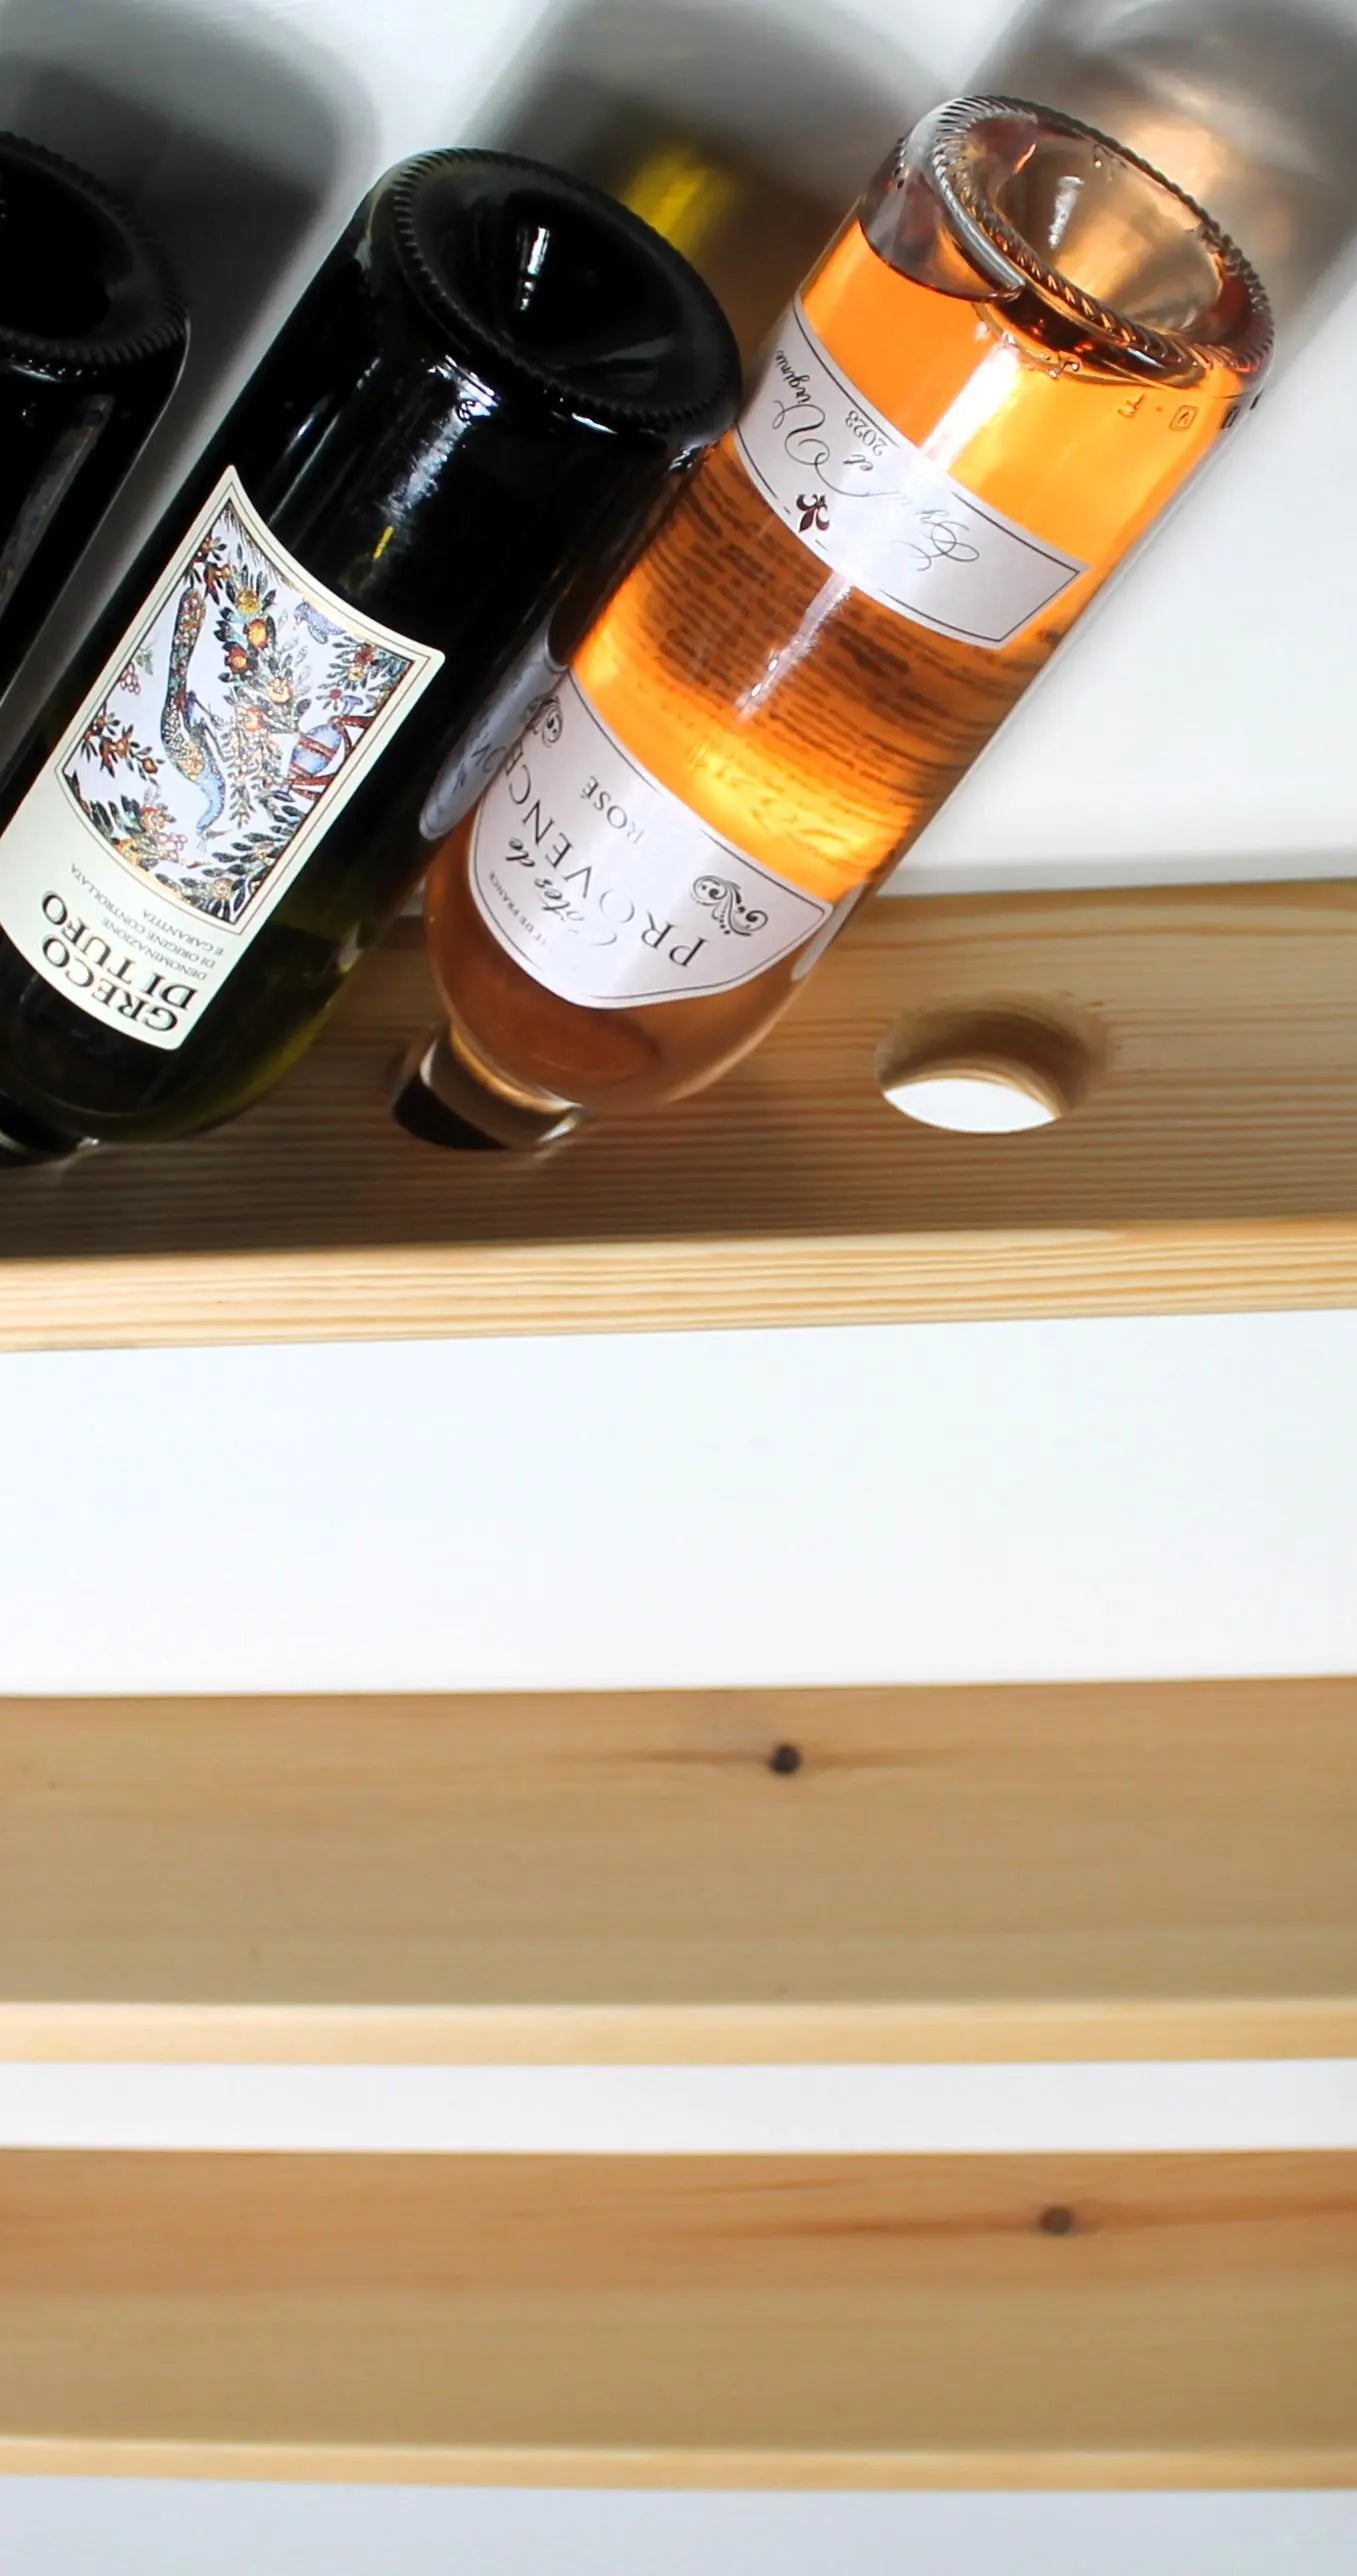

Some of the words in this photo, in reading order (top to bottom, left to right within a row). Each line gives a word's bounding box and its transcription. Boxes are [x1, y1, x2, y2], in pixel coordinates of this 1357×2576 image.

[772, 350, 831, 466] Virginie
[845, 411, 888, 457] 2023
[843, 453, 874, 471] et
[580, 775, 645, 845] ROSÉ
[505, 837, 536, 868] de
[70, 863, 146, 935] CONTROLLATA
[41, 890, 136, 985] TUFO
[142, 909, 215, 953] GARANTITA
[520, 916, 535, 935] DE
[102, 917, 208, 981] DENOMINAZIONE
[149, 933, 206, 963] ORIGINE
[205, 958, 216, 970] DI
[215, 947, 224, 956] E
[42, 934, 178, 1032] GRECO
[140, 971, 198, 1012] DI
